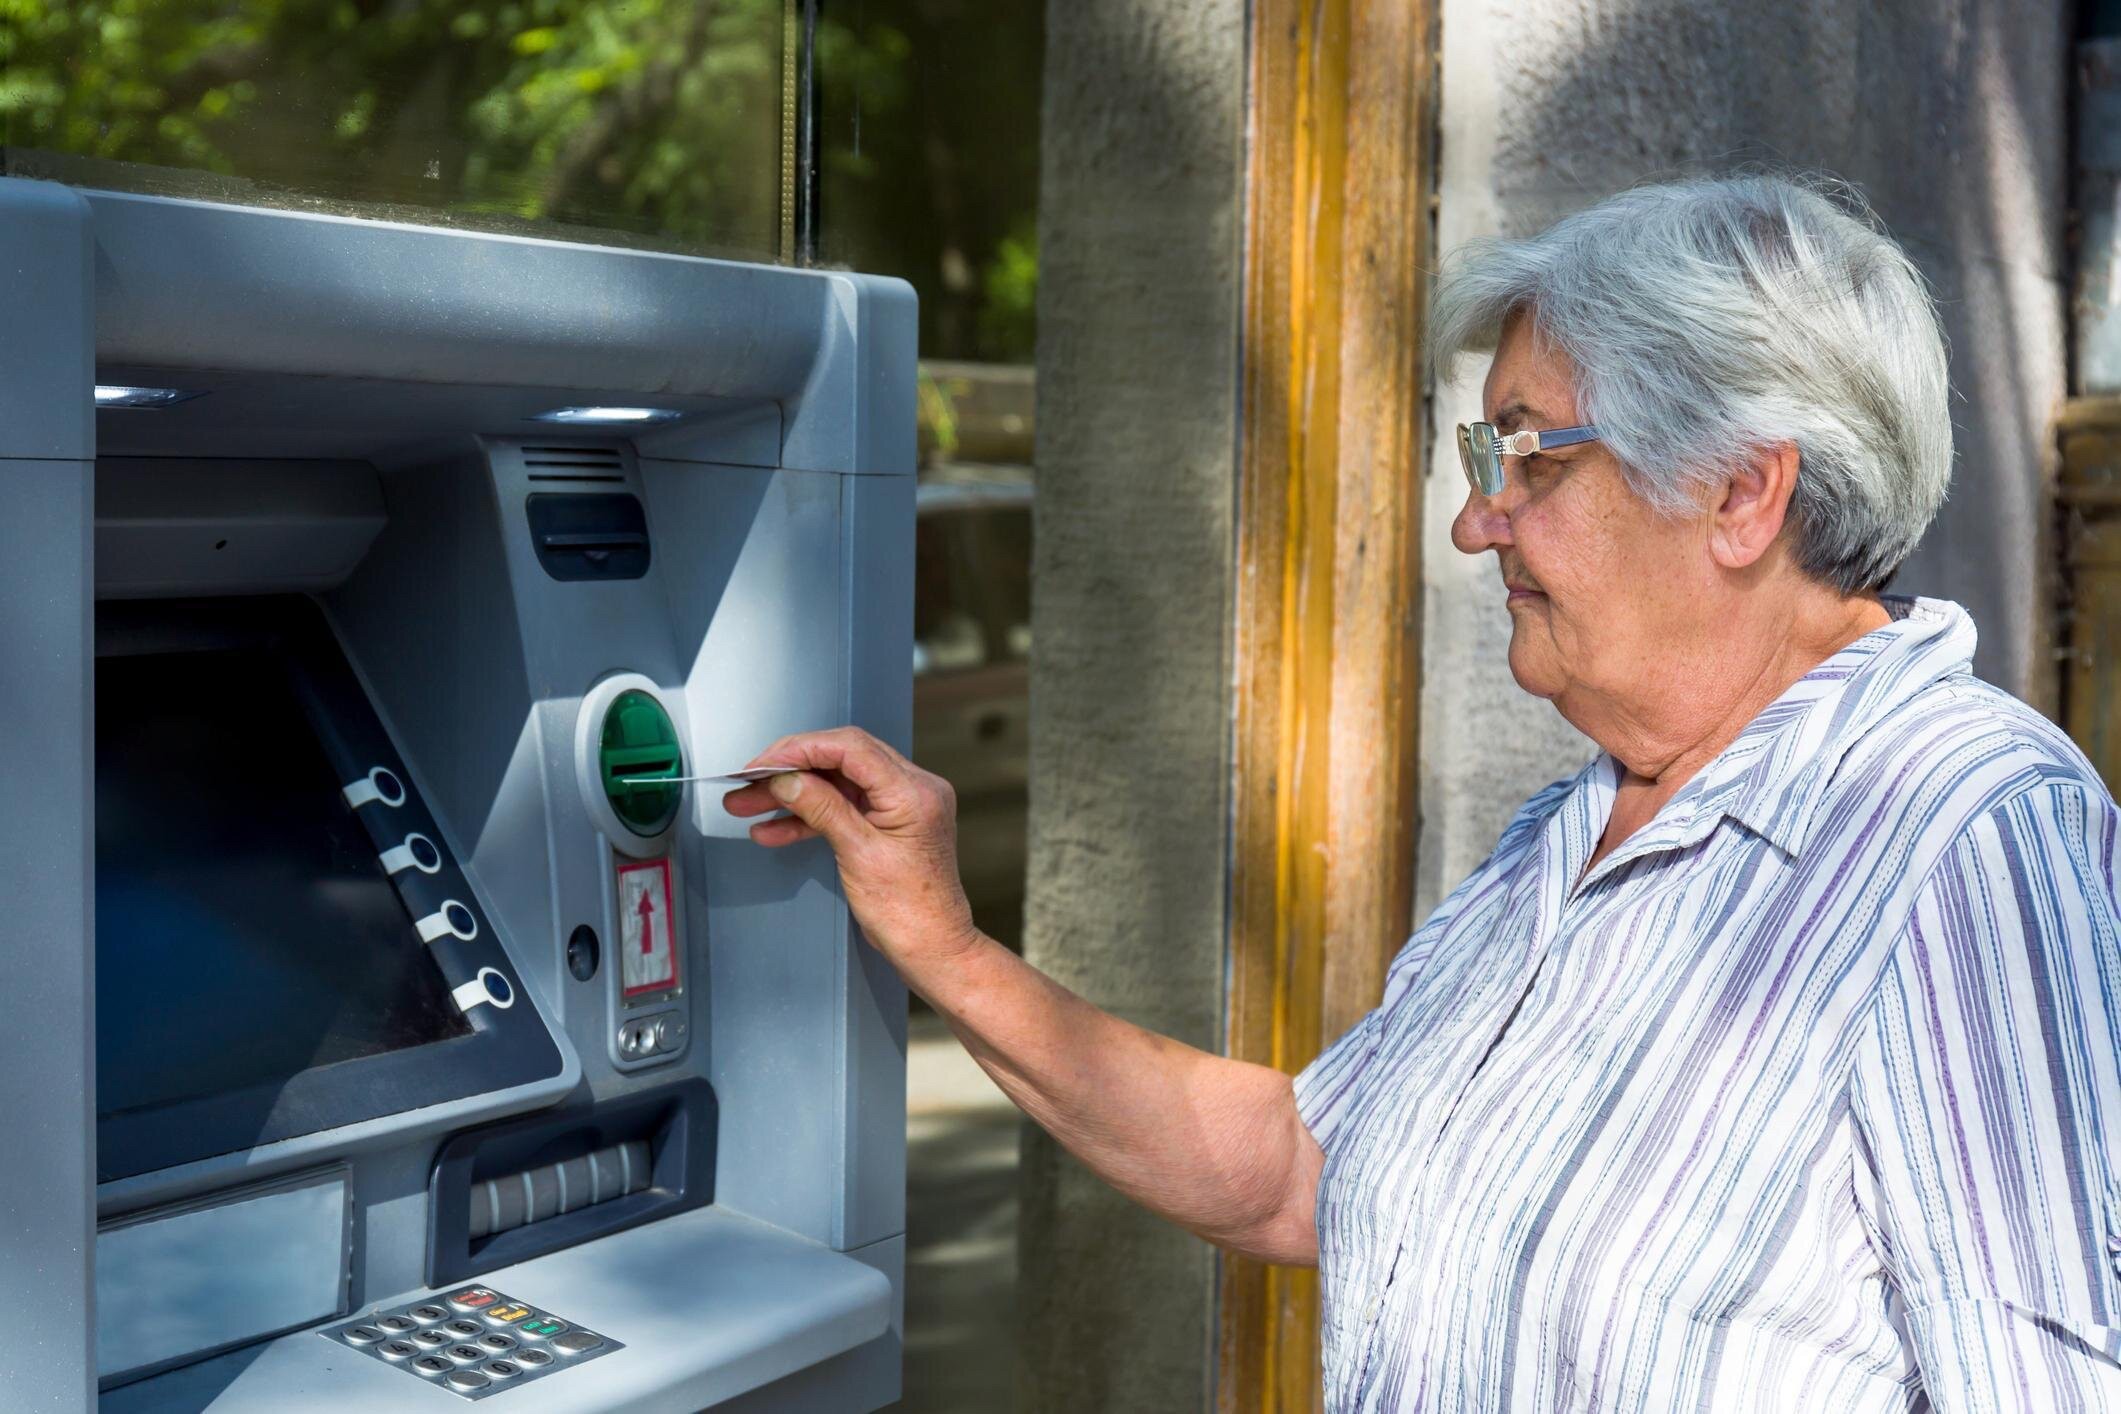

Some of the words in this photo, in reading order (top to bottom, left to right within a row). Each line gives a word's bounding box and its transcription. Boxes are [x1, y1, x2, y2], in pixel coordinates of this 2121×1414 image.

[355, 1329, 373, 1338] 1
[387, 1318, 409, 1328] 2
[418, 1308, 439, 1318] 3
[391, 1344, 410, 1352] 4
[421, 1332, 442, 1342] 5
[455, 1323, 474, 1331] 6
[422, 1358, 442, 1368] 7
[456, 1348, 477, 1357] 8
[488, 1337, 508, 1346] 9
[491, 1363, 511, 1373] 0
